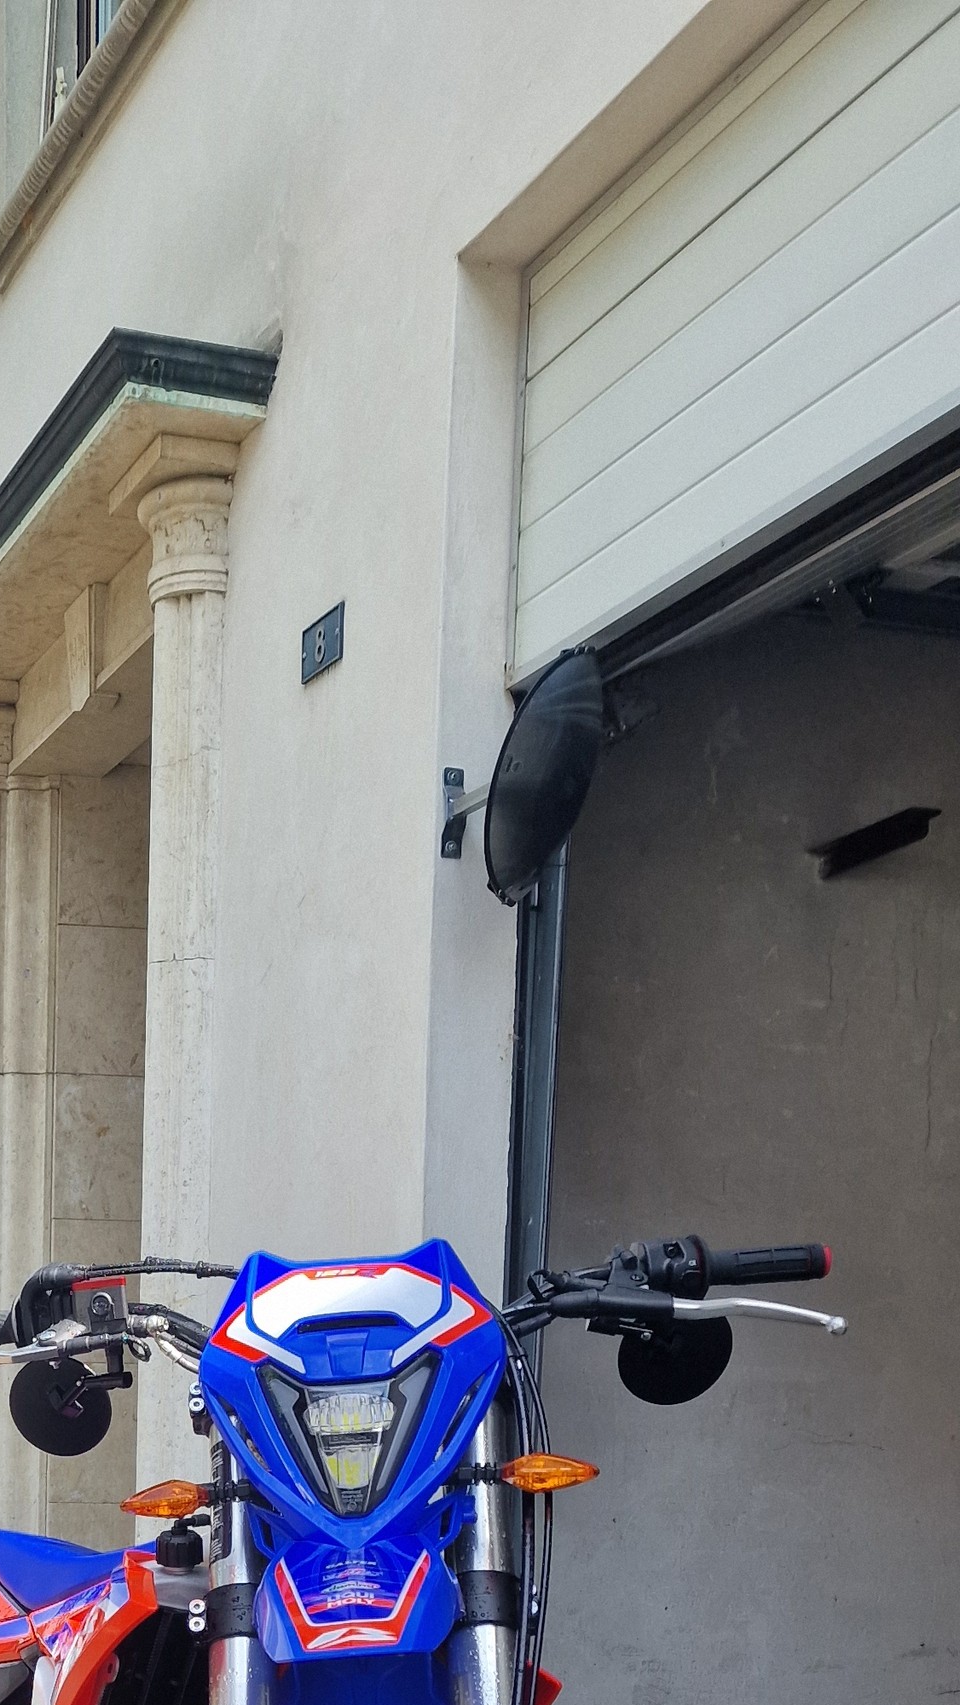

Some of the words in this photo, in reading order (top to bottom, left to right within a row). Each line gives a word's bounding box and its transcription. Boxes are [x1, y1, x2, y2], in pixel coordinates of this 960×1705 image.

[314, 627, 326, 664] 8
[326, 1591, 374, 1602] LIQUI
[327, 1598, 374, 1609] MOLY
